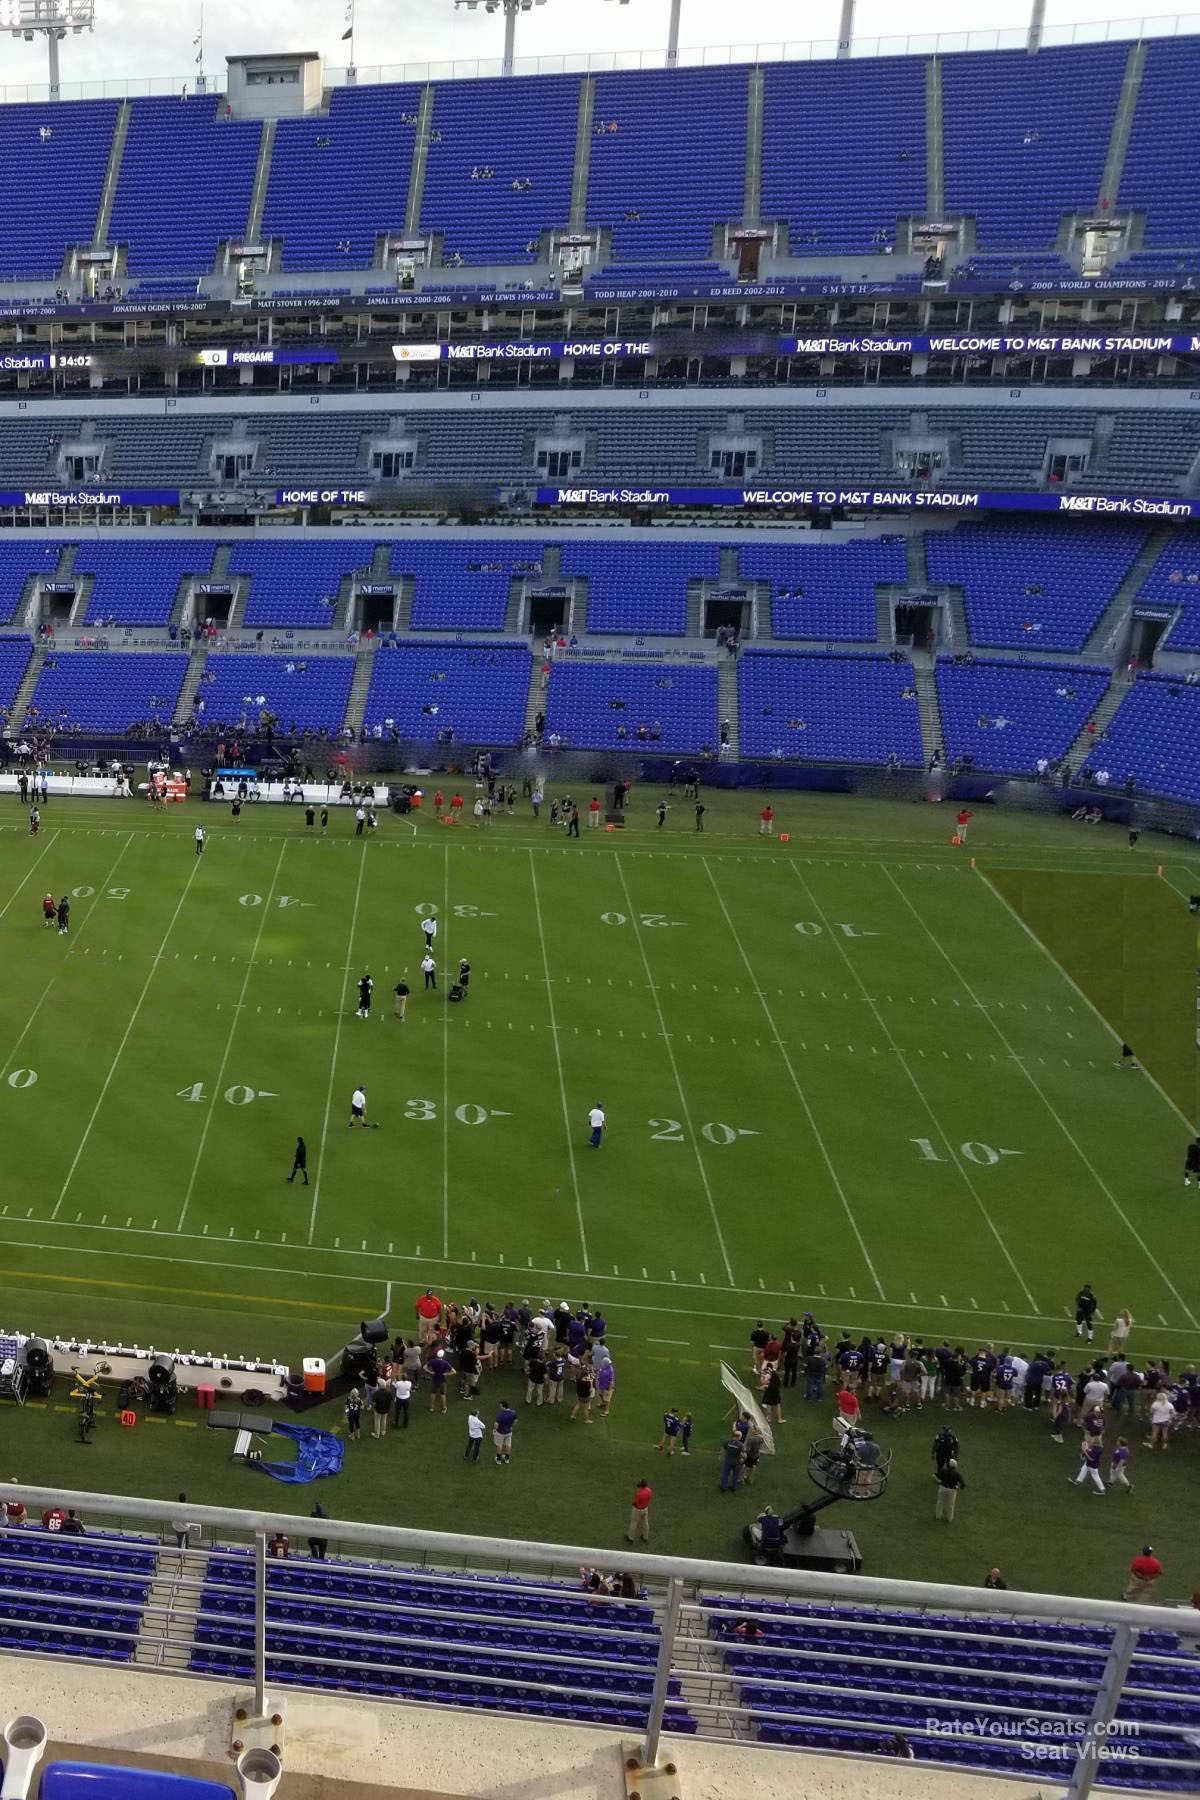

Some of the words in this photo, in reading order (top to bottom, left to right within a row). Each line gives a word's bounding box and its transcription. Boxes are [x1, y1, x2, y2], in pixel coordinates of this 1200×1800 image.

[710, 288, 721, 296] ED
[744, 286, 785, 294] 2002-2012
[822, 286, 866, 294] SMYTH
[1032, 282, 1053, 290] 2000
[1094, 280, 1146, 288] CHAMPIONS
[1152, 280, 1176, 288] 2012
[480, 294, 494, 302] RAY
[518, 292, 554, 300] 1996-2012
[616, 290, 637, 298] HEAP
[638, 290, 678, 298] 2001-2010
[258, 300, 276, 308] MATT
[304, 298, 340, 306] 1996-2008
[367, 297, 390, 305] JAMAL
[414, 296, 451, 304] 2000-2006
[112, 305, 146, 313] JONATHAN
[148, 304, 171, 312] OGDEN
[564, 344, 601, 354] HOME
[604, 344, 622, 354] OF
[624, 344, 649, 354] THE
[797, 340, 830, 352] M&T
[830, 340, 860, 352] Bank
[861, 338, 912, 351] Stadium
[929, 338, 1000, 350] WELCOME
[1004, 338, 1024, 350] TO
[1028, 338, 1058, 350] M&T
[1062, 338, 1102, 350] BANK
[1105, 338, 1172, 350] STADIUM
[212, 352, 220, 363] 0
[233, 352, 274, 363] PREGAME
[448, 346, 478, 358] M&T
[478, 346, 504, 357] Bank
[506, 345, 550, 356] Stadium
[5, 356, 44, 368] Stadium
[25, 493, 52, 504] M&T
[52, 493, 78, 504] Bank
[78, 492, 120, 504] Stadium
[282, 492, 318, 502] HOME
[322, 492, 339, 502] OF
[341, 491, 365, 502] THE
[558, 490, 590, 502] M&T
[590, 490, 619, 502] Bank
[620, 490, 670, 502] Stadium
[743, 491, 813, 503] WELCOME
[816, 492, 836, 504] TO
[839, 492, 870, 504] M&T
[873, 492, 912, 504] BANK
[915, 494, 978, 506] STADIUM
[1059, 496, 1096, 510] M&T
[1096, 498, 1131, 512] Bank
[1132, 499, 1191, 516] Stadium
[72, 886, 131, 900] 50
[238, 894, 300, 909] 40
[414, 902, 481, 919] 30
[600, 912, 668, 928] 20
[794, 921, 862, 938] 10
[176, 1082, 256, 1106] 40
[403, 1098, 488, 1125] 30
[647, 1117, 737, 1146] 20
[909, 1137, 1001, 1166] 10
[1054, 1380, 1066, 1390] 52
[122, 1412, 133, 1422] 40
[48, 1518, 61, 1530] 85
